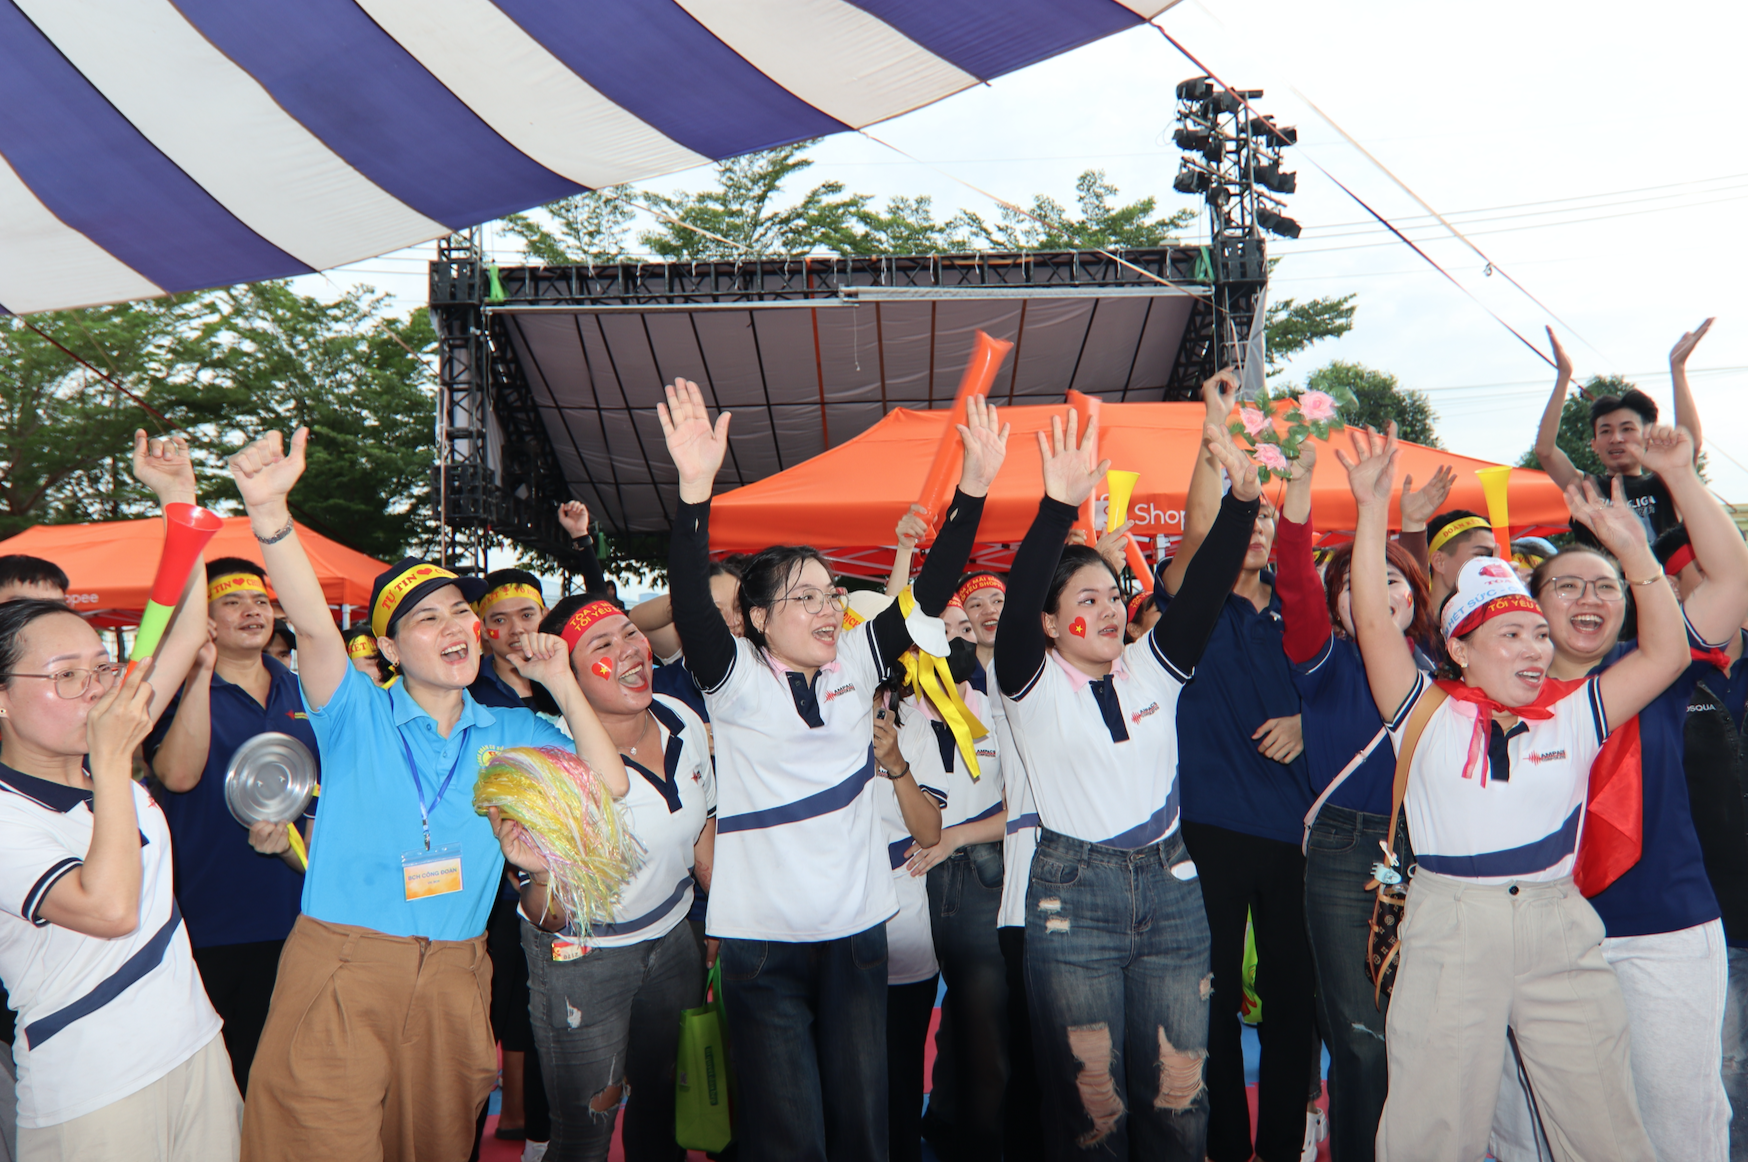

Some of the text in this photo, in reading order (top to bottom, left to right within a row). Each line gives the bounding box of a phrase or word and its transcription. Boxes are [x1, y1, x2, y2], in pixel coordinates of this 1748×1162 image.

[214, 580, 232, 594] TIN
[381, 573, 417, 611] TỰ TIN
[1467, 588, 1498, 609] SỨC
[1488, 600, 1509, 612] TÔI
[1511, 599, 1534, 609] YÊU
